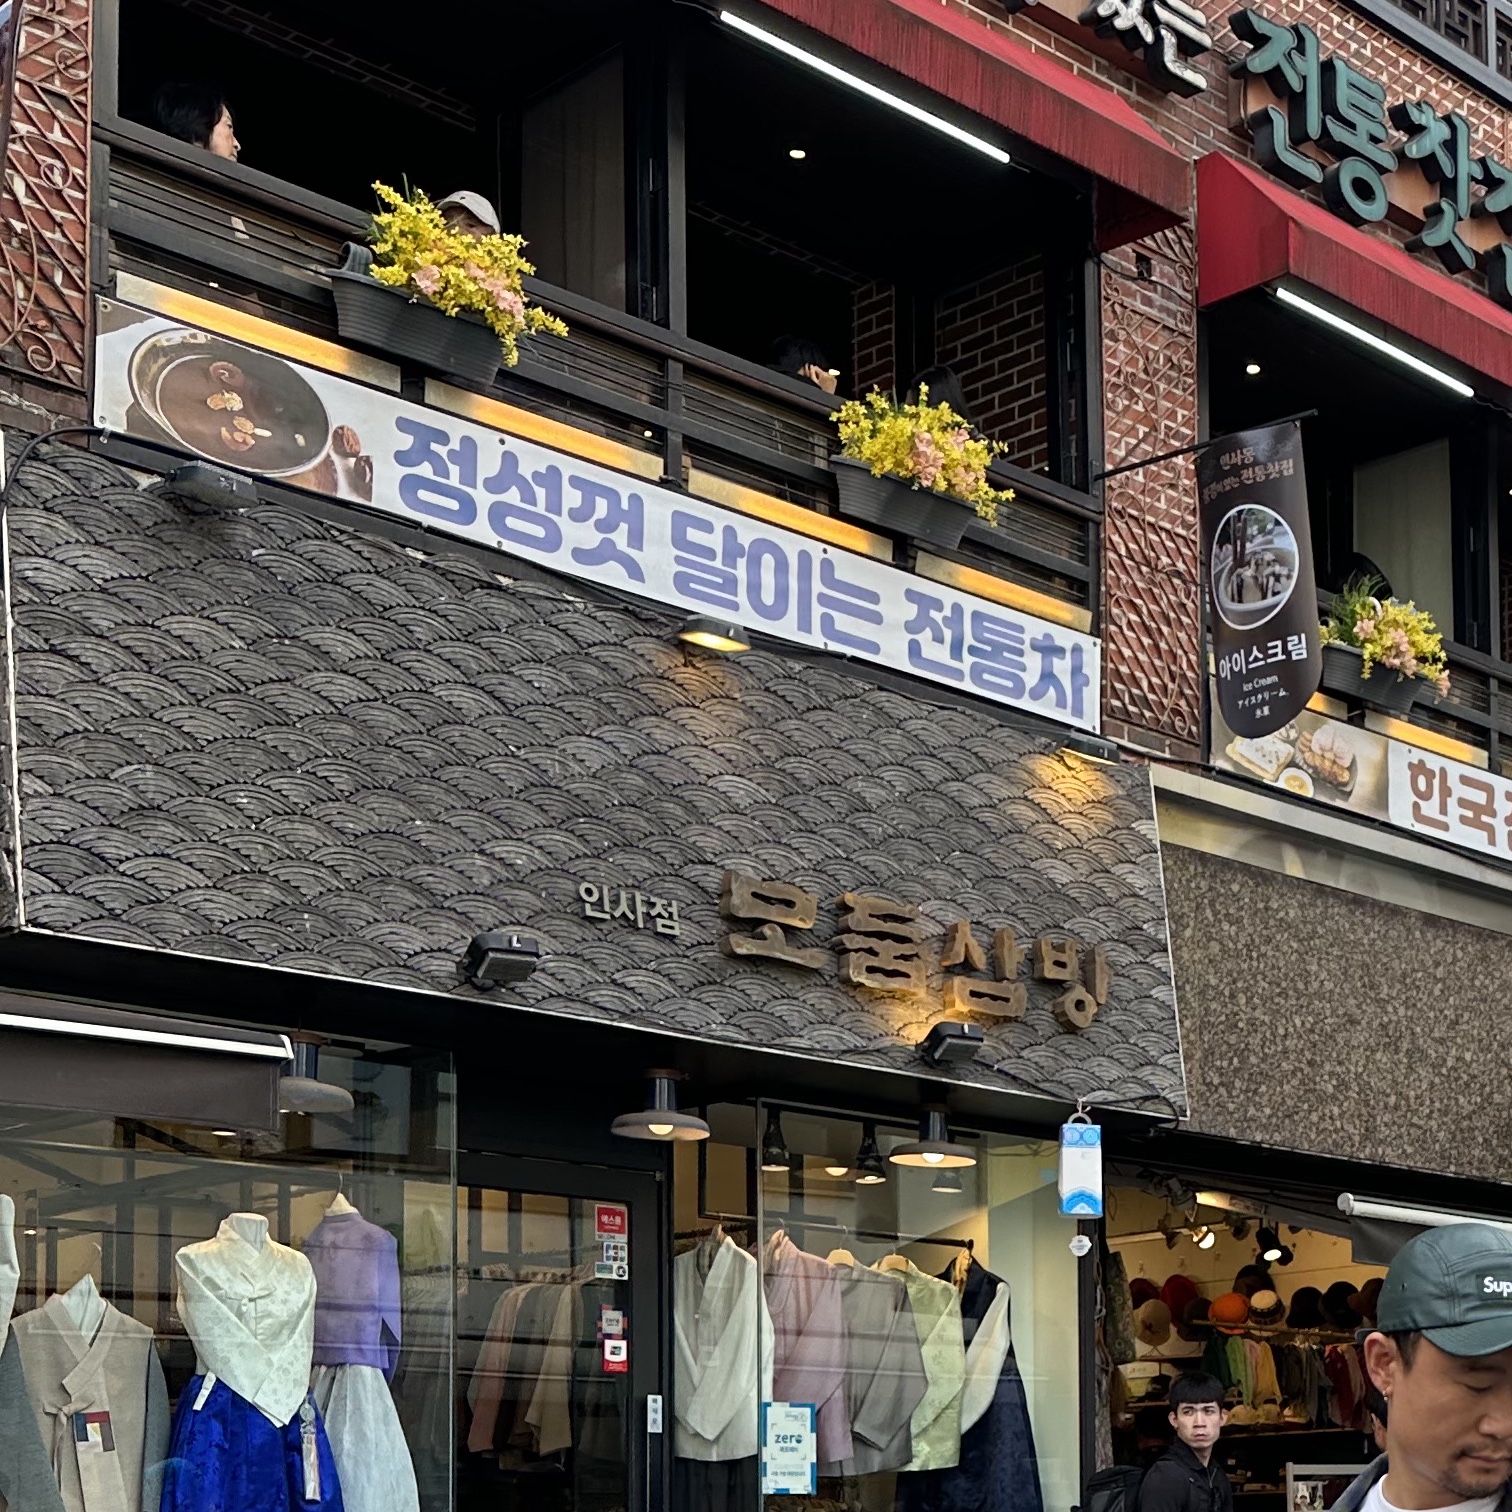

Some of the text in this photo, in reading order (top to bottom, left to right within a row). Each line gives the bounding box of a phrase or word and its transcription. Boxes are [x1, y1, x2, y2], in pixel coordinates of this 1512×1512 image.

[1220, 446, 1255, 471] 인사동
[1240, 458, 1295, 485] 전통찻집
[394, 416, 1091, 720] 정성껏 달이는 전통차
[1219, 633, 1308, 681] 아이스크림
[1242, 674, 1278, 691] Ice Cream
[579, 881, 680, 937] 인사점
[775, 1434, 803, 1444] zero
